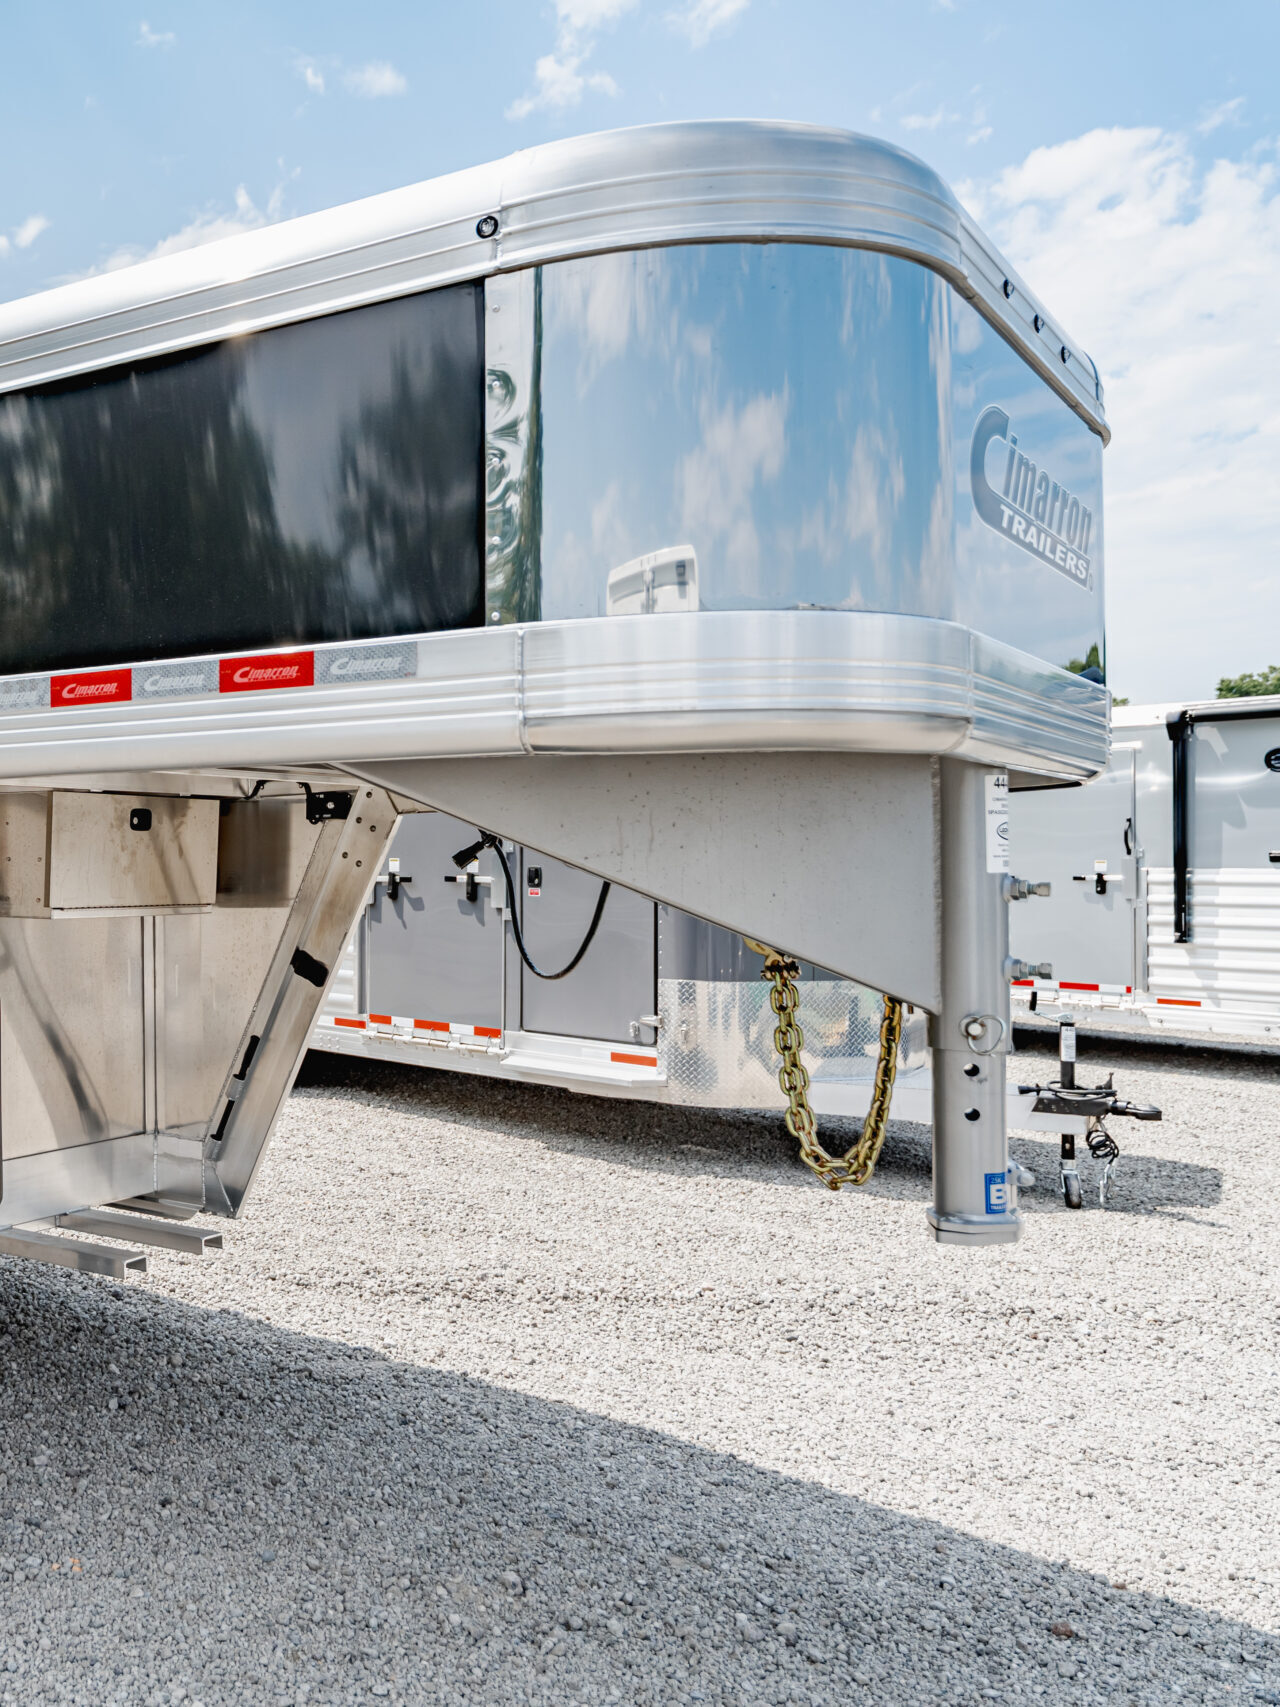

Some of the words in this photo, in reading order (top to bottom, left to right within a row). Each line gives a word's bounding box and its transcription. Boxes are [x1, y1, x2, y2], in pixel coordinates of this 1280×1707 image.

[970, 403, 1093, 562] Cimarron
[999, 503, 1088, 580] TRAILERS
[62, 682, 119, 699] Cimarron
[233, 665, 300, 684] Cimarron
